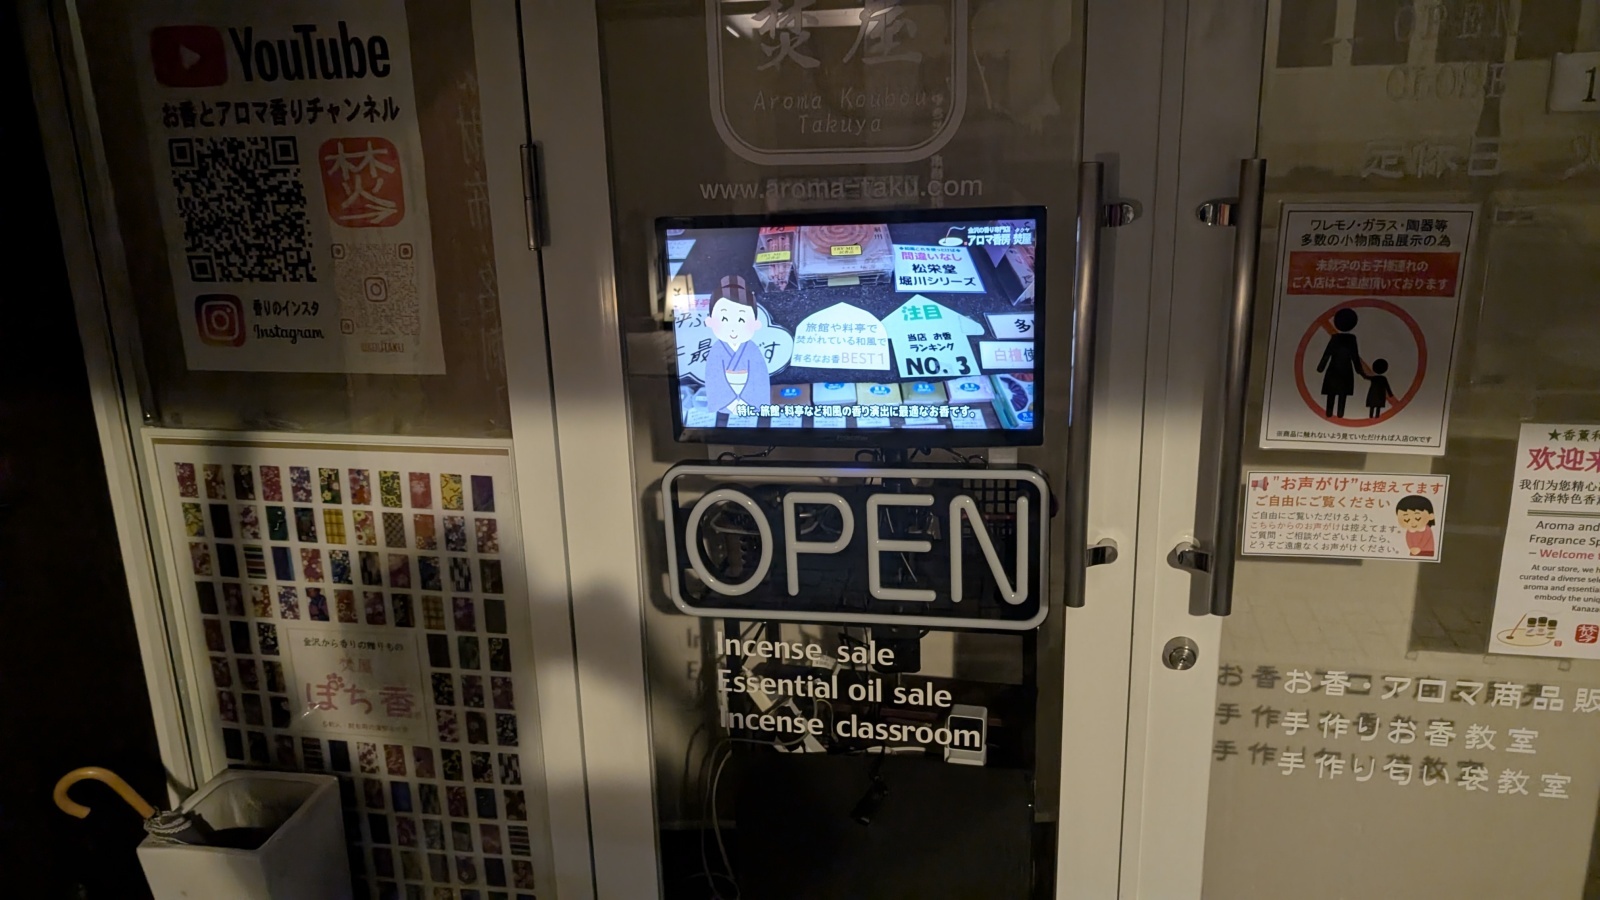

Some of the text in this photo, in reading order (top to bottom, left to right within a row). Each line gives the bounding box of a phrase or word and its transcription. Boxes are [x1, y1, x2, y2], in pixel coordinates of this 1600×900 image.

[229, 21, 390, 82] YouTube
[754, 90, 822, 111] Aroma
[162, 95, 400, 128] お香とアロマ香りチャンネル
[799, 114, 881, 136] Takuya
[699, 177, 983, 199] www.aroma-taku.com
[1310, 218, 1448, 232] ワレモノ・ガラス・陶器等
[1301, 233, 1451, 248] 多数の小物商品展示の為
[901, 252, 962, 262] 間違いなし
[912, 263, 958, 274] 松栄堂
[1316, 259, 1429, 273] 未就学のお子様連れの
[899, 275, 976, 287] 堀川シリーズ
[1292, 276, 1449, 291] ご入店はご遠慮頂いております
[901, 304, 942, 321] 注目
[253, 324, 324, 344] Instagram
[806, 322, 877, 334] 旅館や料亭で
[796, 335, 887, 347] 焚かれている和風で
[908, 333, 927, 342] 当店
[910, 343, 954, 352] ランキング
[906, 356, 971, 376] NO. 3
[737, 404, 975, 418] 特に、旅館・料亭など和風の香り演出に最適なお香です。
[1519, 479, 1600, 492] 我们为您精心
[1256, 495, 1390, 509] ご自由にご覧ください
[1252, 511, 1373, 522] ご自由にご覧いただけるよう、
[1251, 522, 1401, 534] こちらからのお声がけは控えてます。
[1536, 521, 1575, 531] Aroma
[1250, 531, 1390, 543] ご質問・ご相談がございましたら、
[1529, 535, 1586, 546] Fragrance
[685, 489, 1028, 605] OPEN
[1250, 541, 1399, 554] どうぞご遠慮なくお声がけください。
[1540, 549, 1594, 560] Welcome
[1534, 594, 1566, 602] embody
[1572, 605, 1600, 613] Kanaza
[717, 631, 822, 661] Incense
[838, 641, 895, 666] sale
[718, 669, 952, 707] Essential oil sale
[720, 709, 981, 747] Incense classroom
[1281, 710, 1539, 754] 手作りお香教室
[1277, 751, 1572, 800] 手作り匂い袋教室
